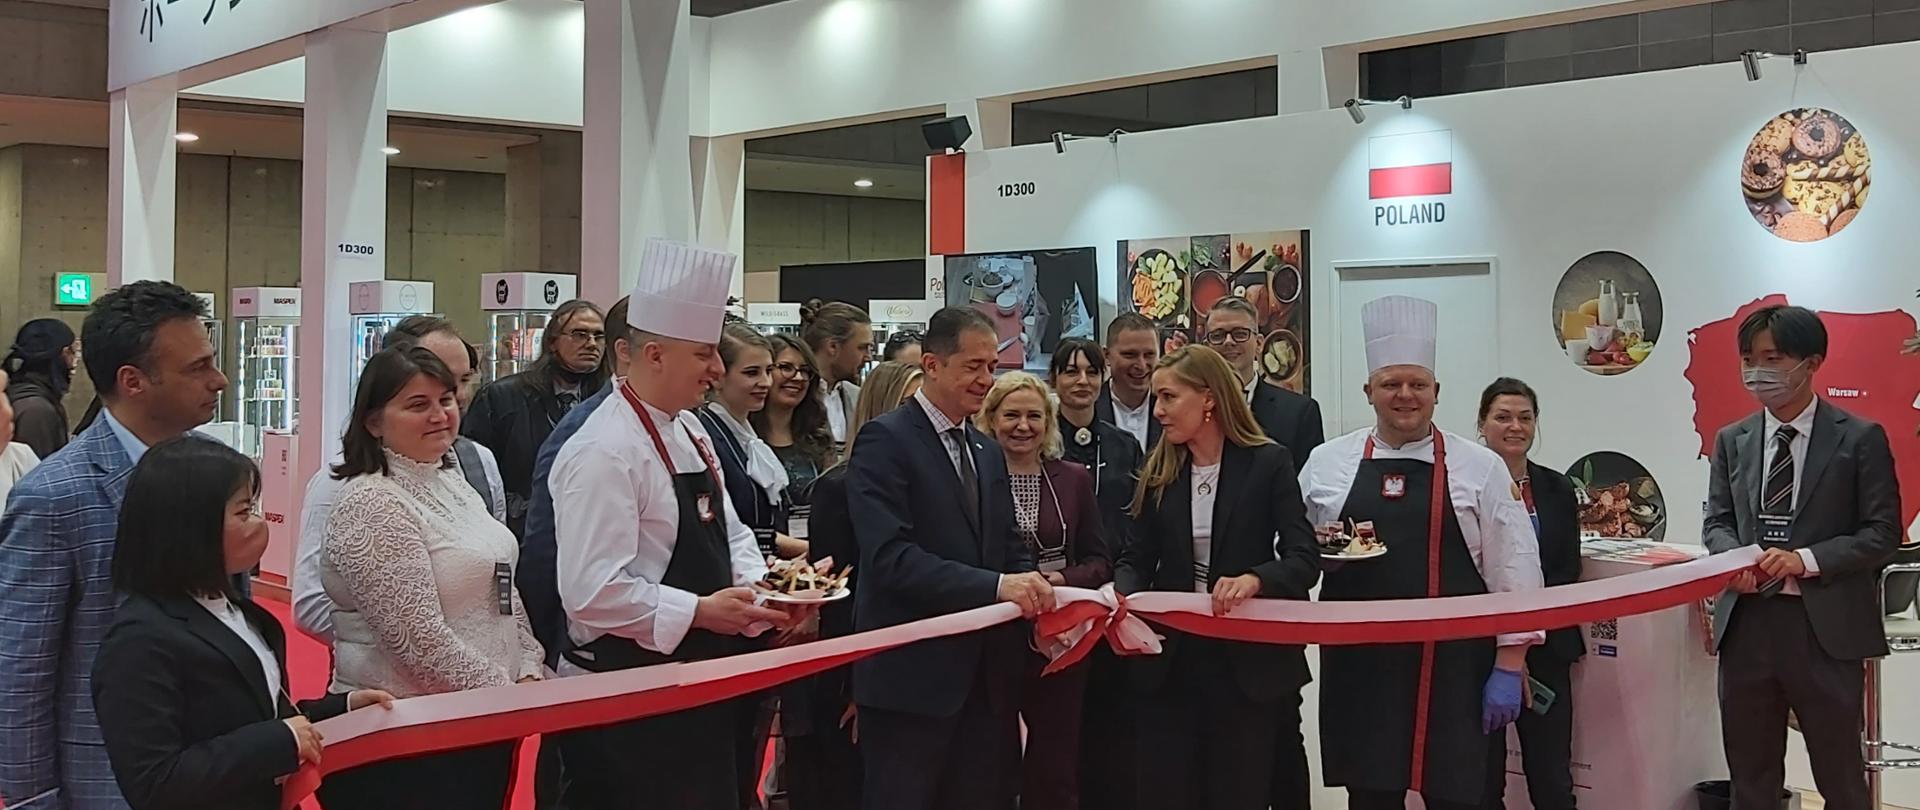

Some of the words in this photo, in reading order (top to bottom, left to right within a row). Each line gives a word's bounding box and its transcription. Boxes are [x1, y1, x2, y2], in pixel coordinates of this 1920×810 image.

[997, 182, 1035, 197] 1D300
[1375, 202, 1445, 226] POLAND
[338, 243, 374, 255] 1D300
[1827, 387, 1859, 397] Warsaw
